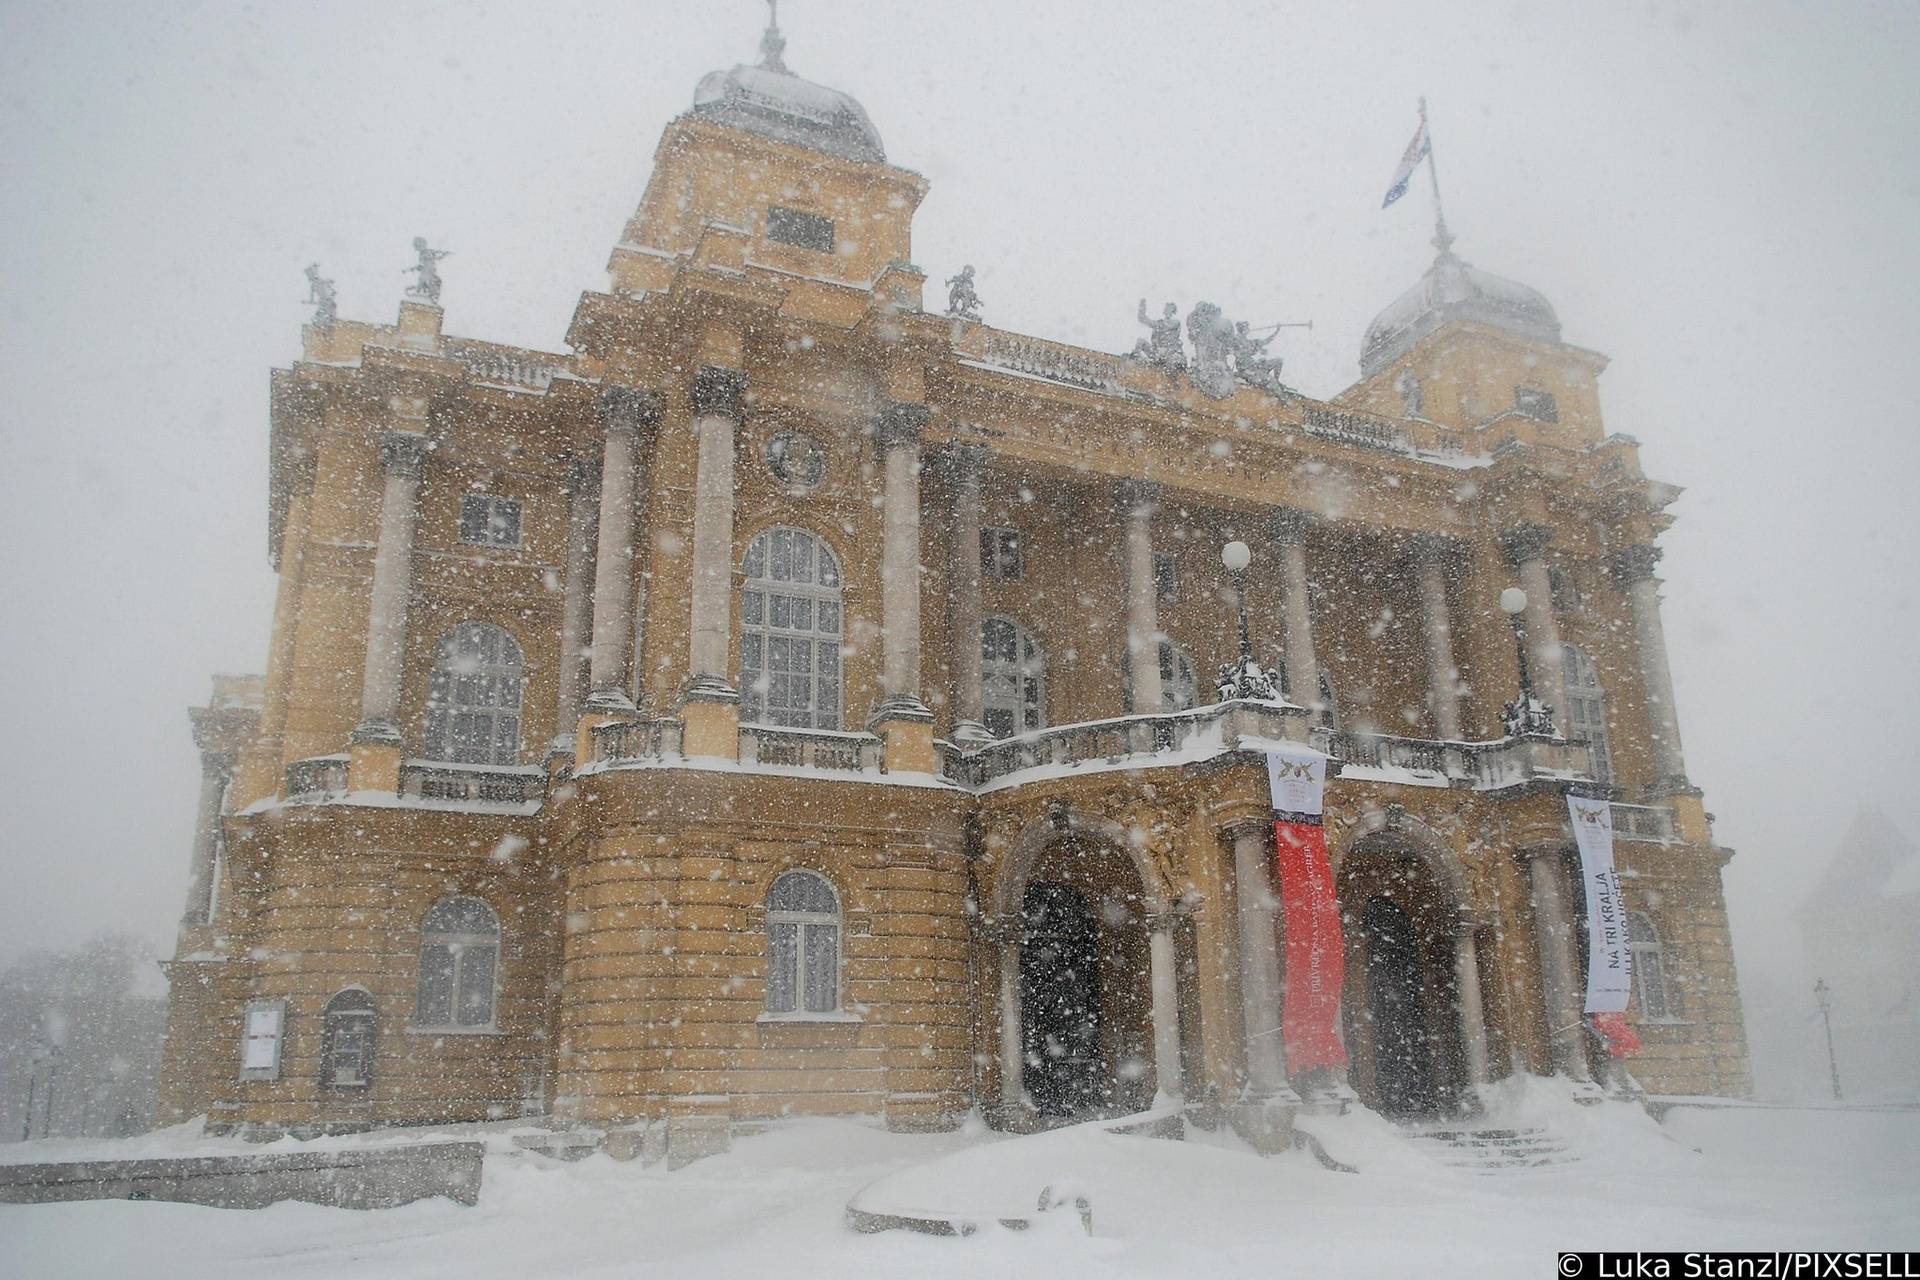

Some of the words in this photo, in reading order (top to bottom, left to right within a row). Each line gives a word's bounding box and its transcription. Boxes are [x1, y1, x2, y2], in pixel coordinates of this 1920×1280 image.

[1595, 872, 1615, 922] KRALJA
[1605, 927, 1617, 946] TRI
[1607, 950, 1619, 969] NA
